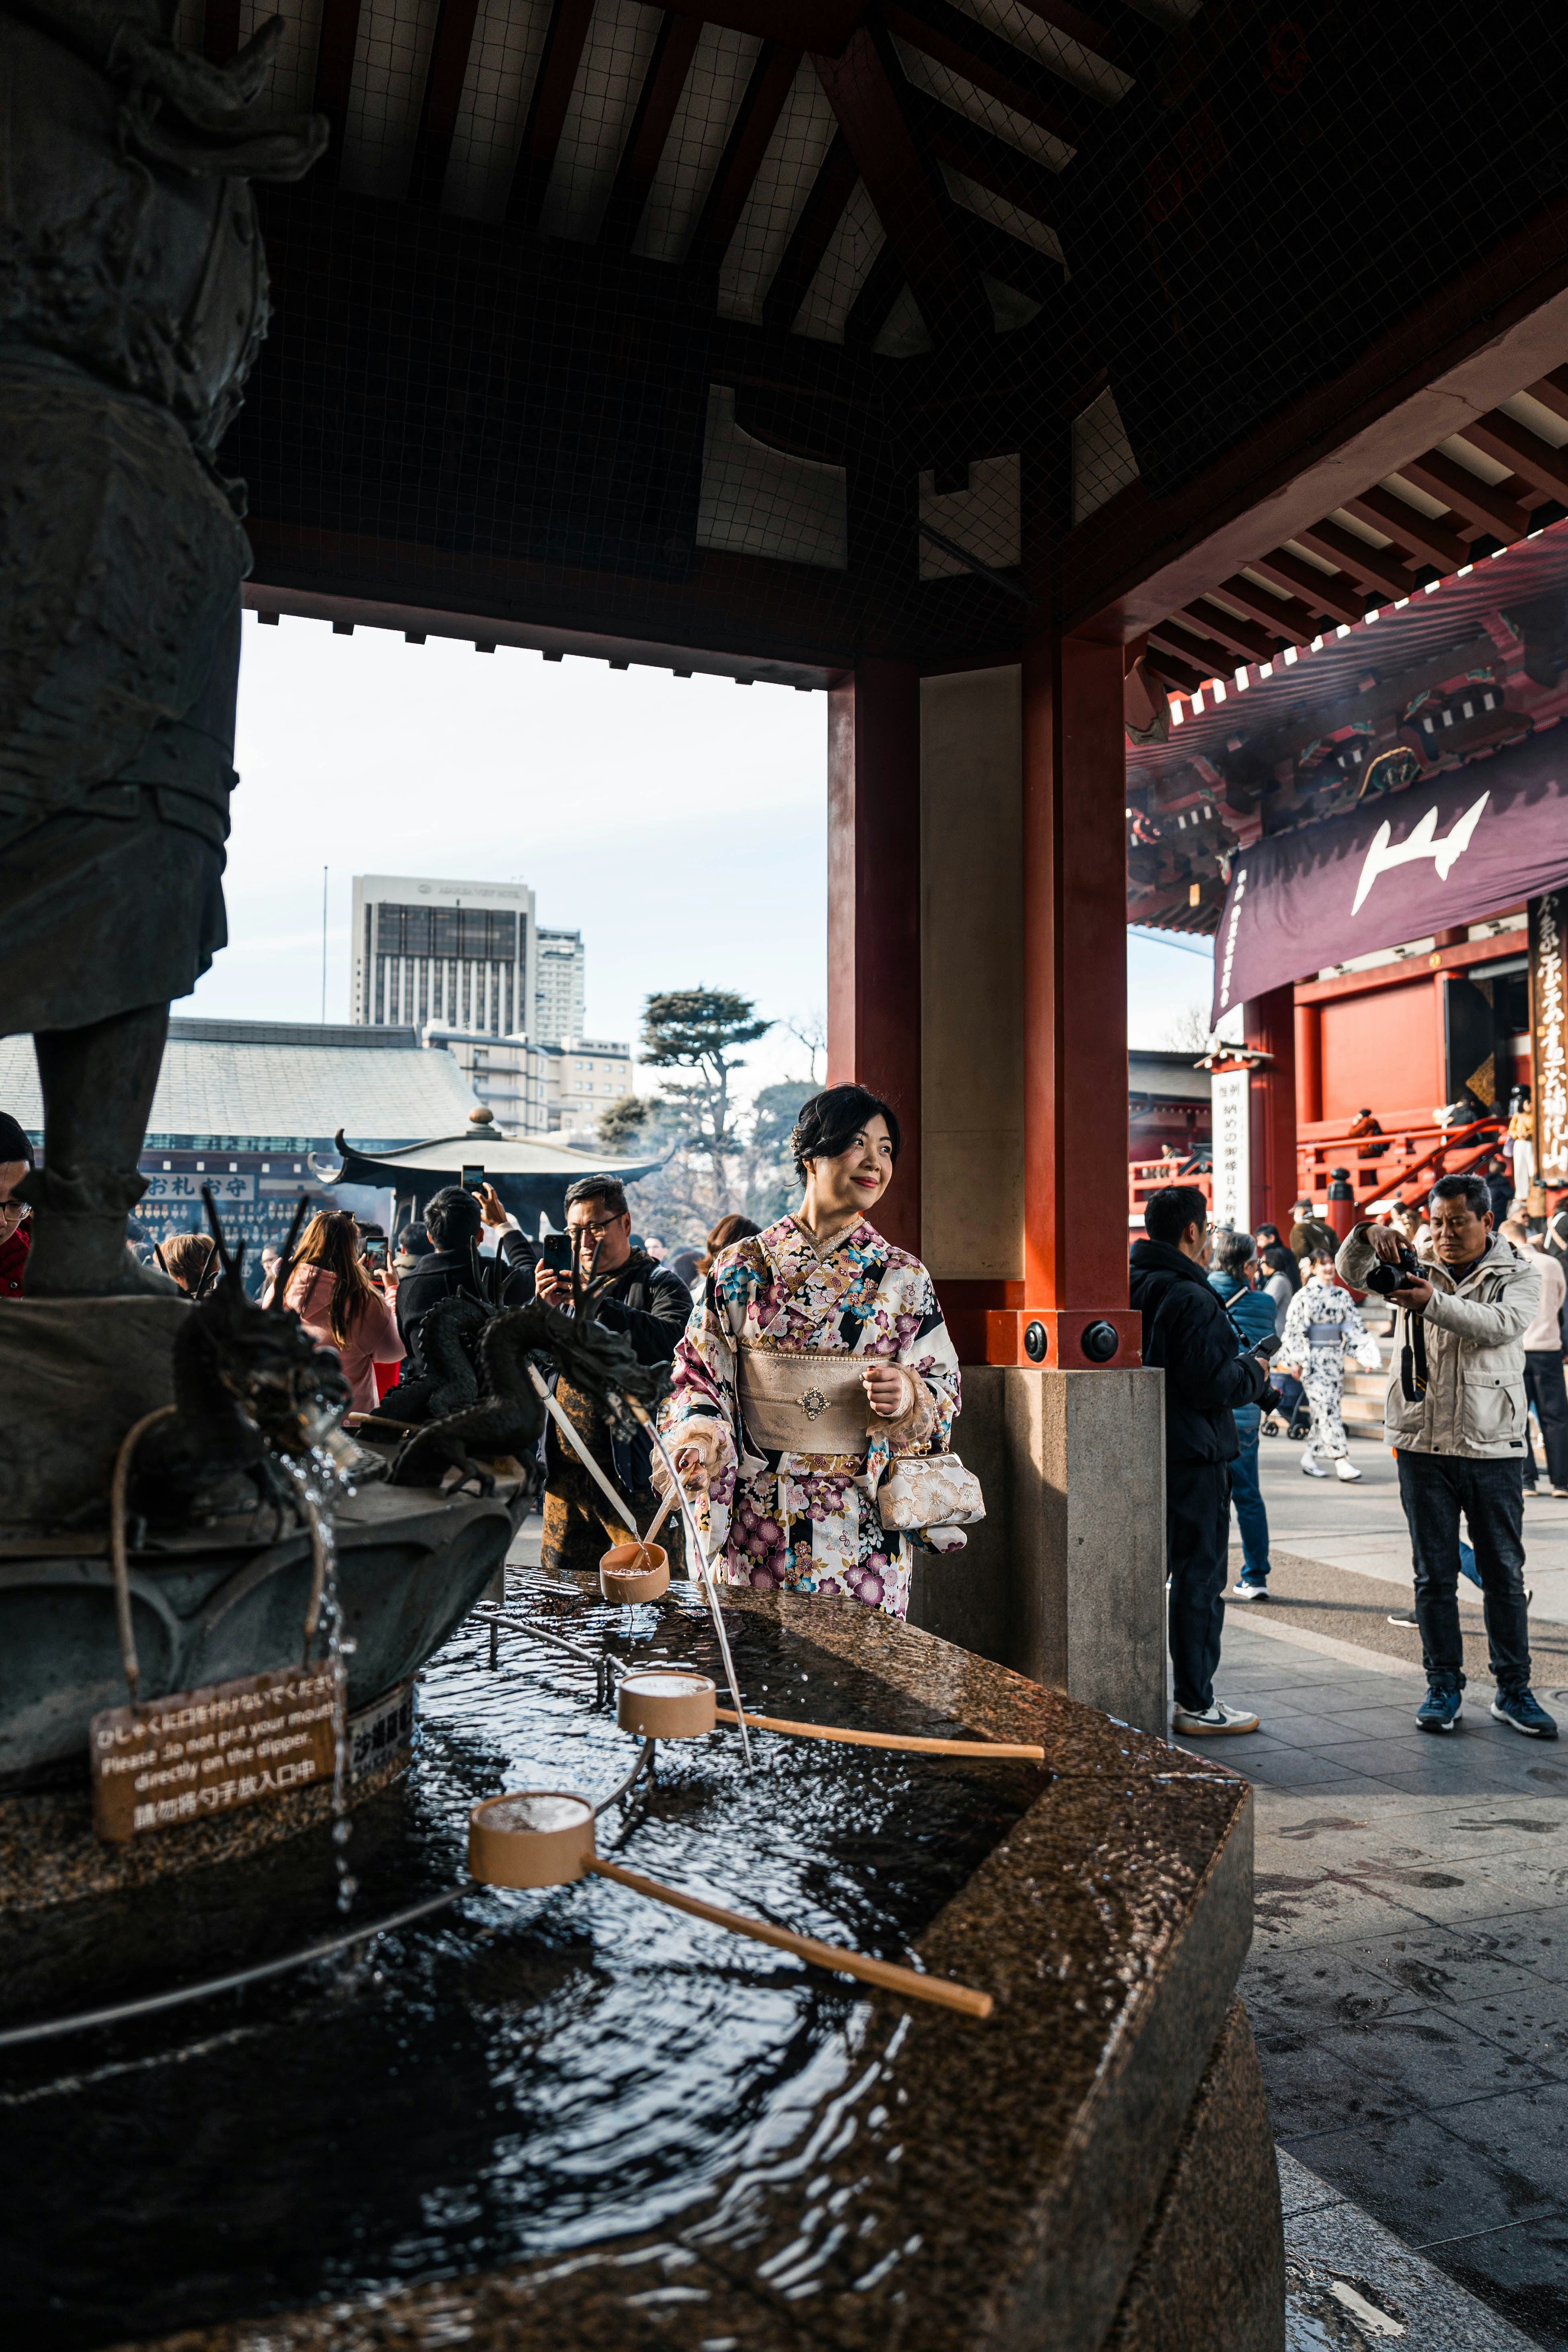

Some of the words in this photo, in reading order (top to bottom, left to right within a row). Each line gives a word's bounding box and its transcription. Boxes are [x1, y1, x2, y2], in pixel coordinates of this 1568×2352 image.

[101, 1750, 157, 1776] Please
[162, 1741, 184, 1762] do
[186, 1733, 215, 1755] not
[218, 1725, 246, 1748] put
[249, 1716, 285, 1741] your
[134, 1760, 199, 1792] directly
[201, 1755, 225, 1773] on
[227, 1747, 254, 1767] the
[256, 1731, 313, 1758] dipper.
